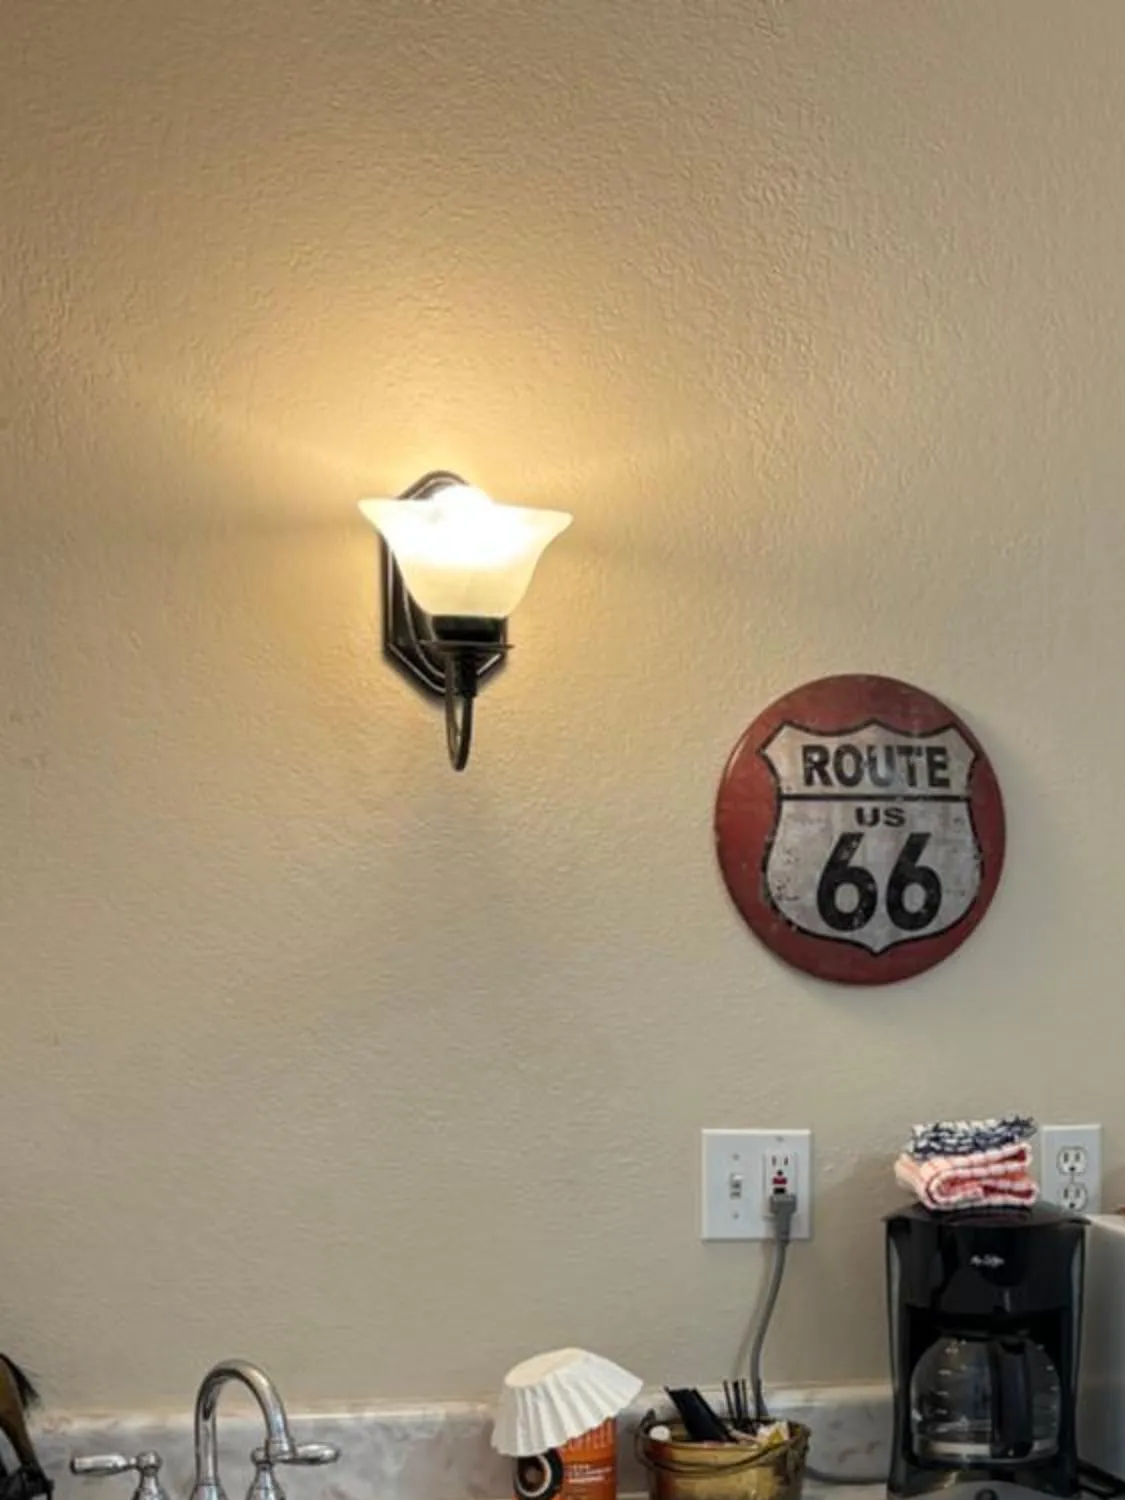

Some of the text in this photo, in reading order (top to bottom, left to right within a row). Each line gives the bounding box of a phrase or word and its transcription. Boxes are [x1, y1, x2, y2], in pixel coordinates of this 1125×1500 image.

[801, 743, 951, 788] ROUTE
[854, 806, 906, 828] US
[816, 831, 942, 932] 66
